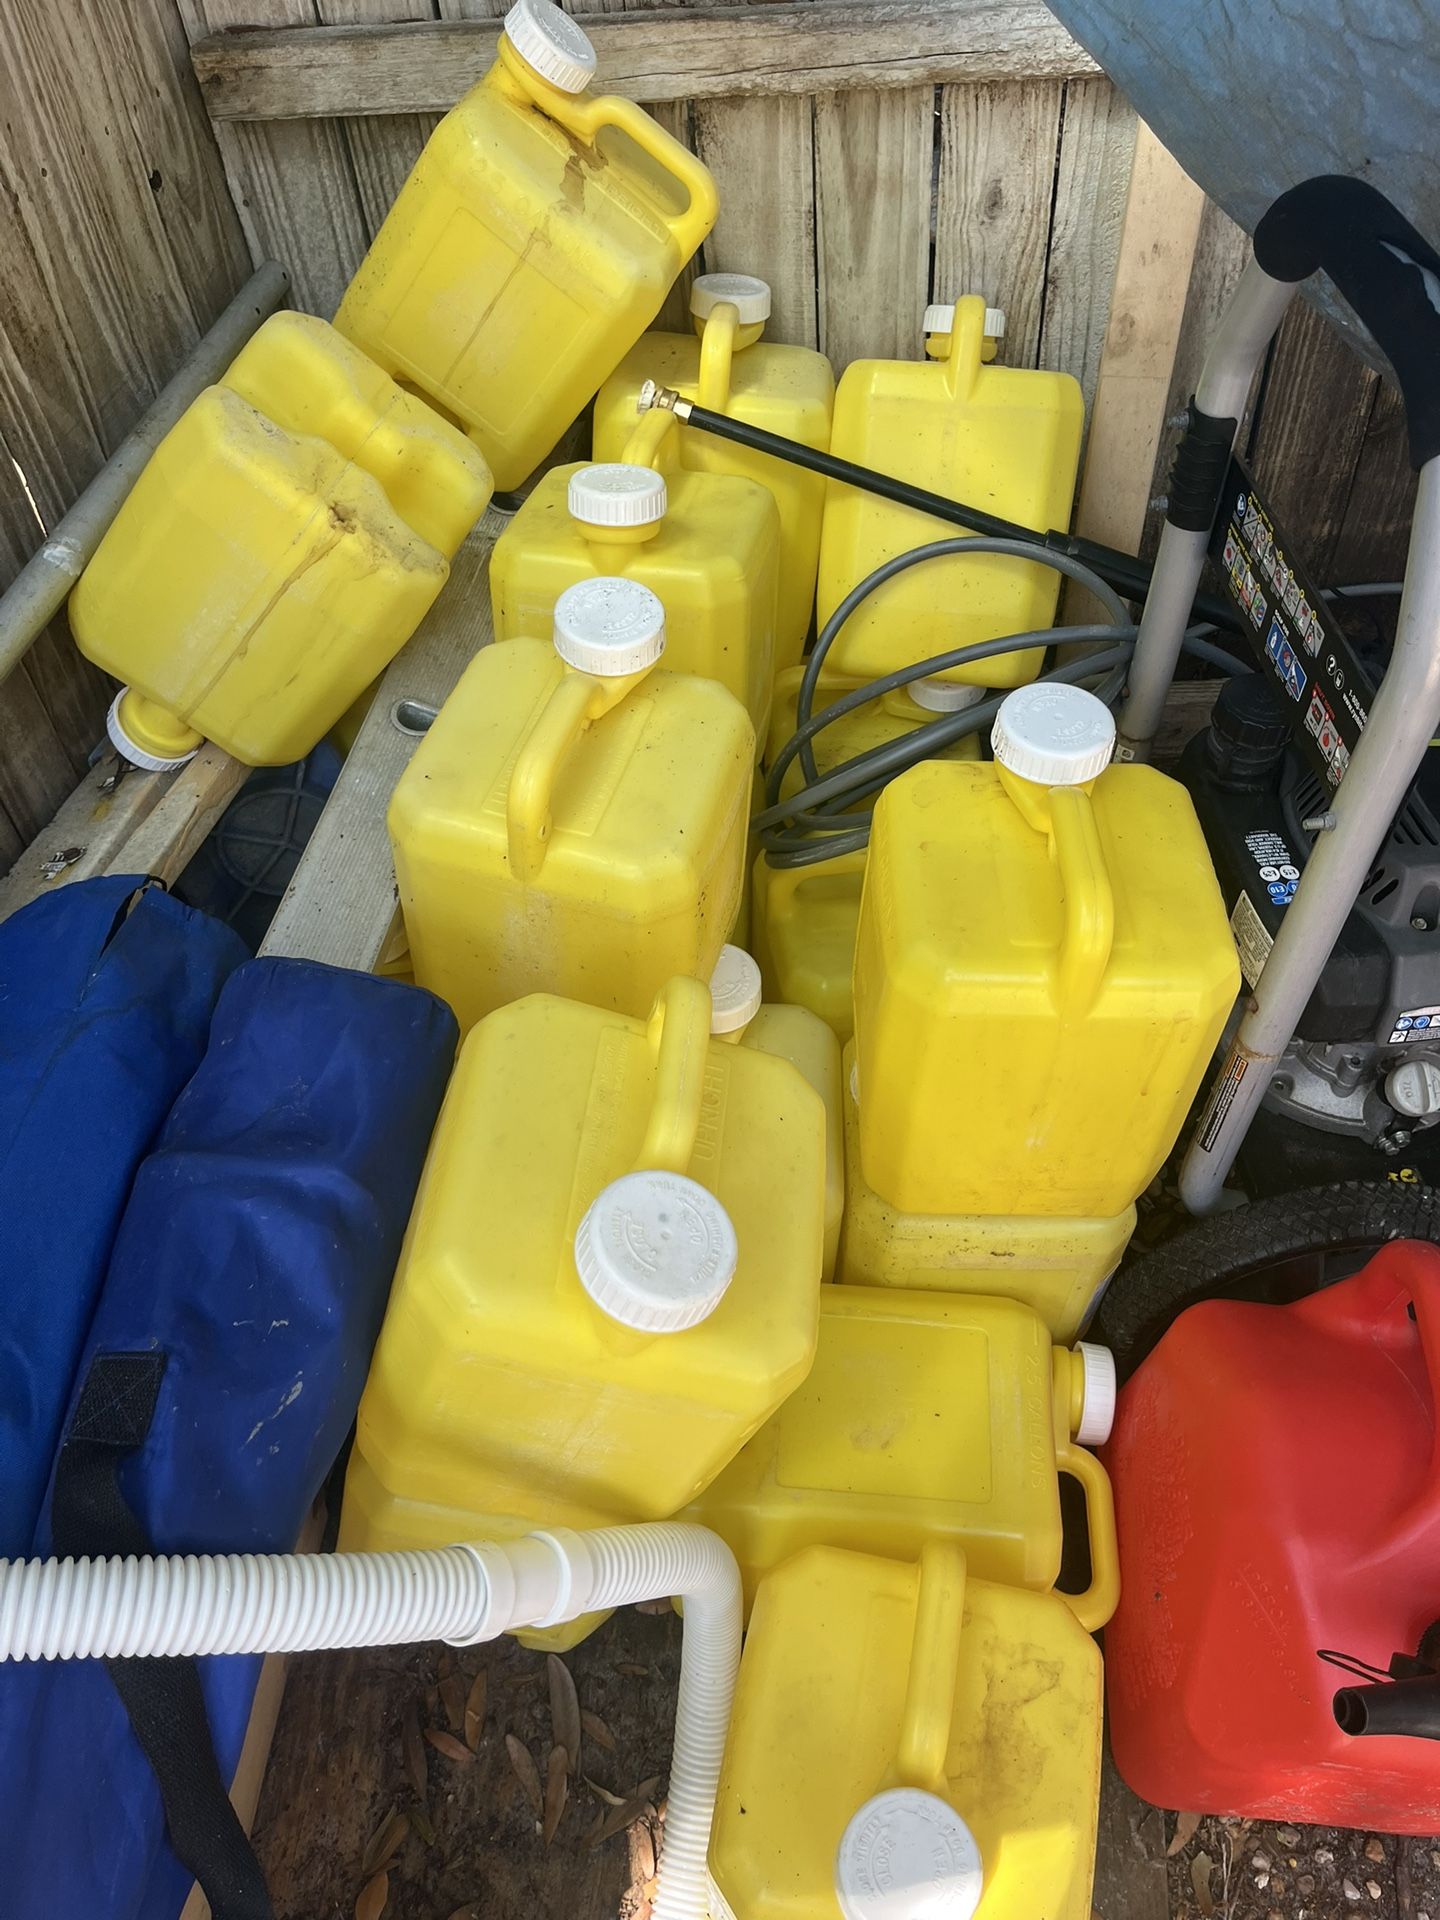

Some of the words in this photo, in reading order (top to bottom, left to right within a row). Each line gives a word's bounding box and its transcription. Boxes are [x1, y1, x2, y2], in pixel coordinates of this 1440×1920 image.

[1270, 885, 1285, 894] E10
[695, 1062, 725, 1162] UPRIGHT
[1025, 1353, 1043, 1386] 2.5
[1025, 1397, 1048, 1490] GALLONS
[877, 1839, 897, 1887] CLOSE
